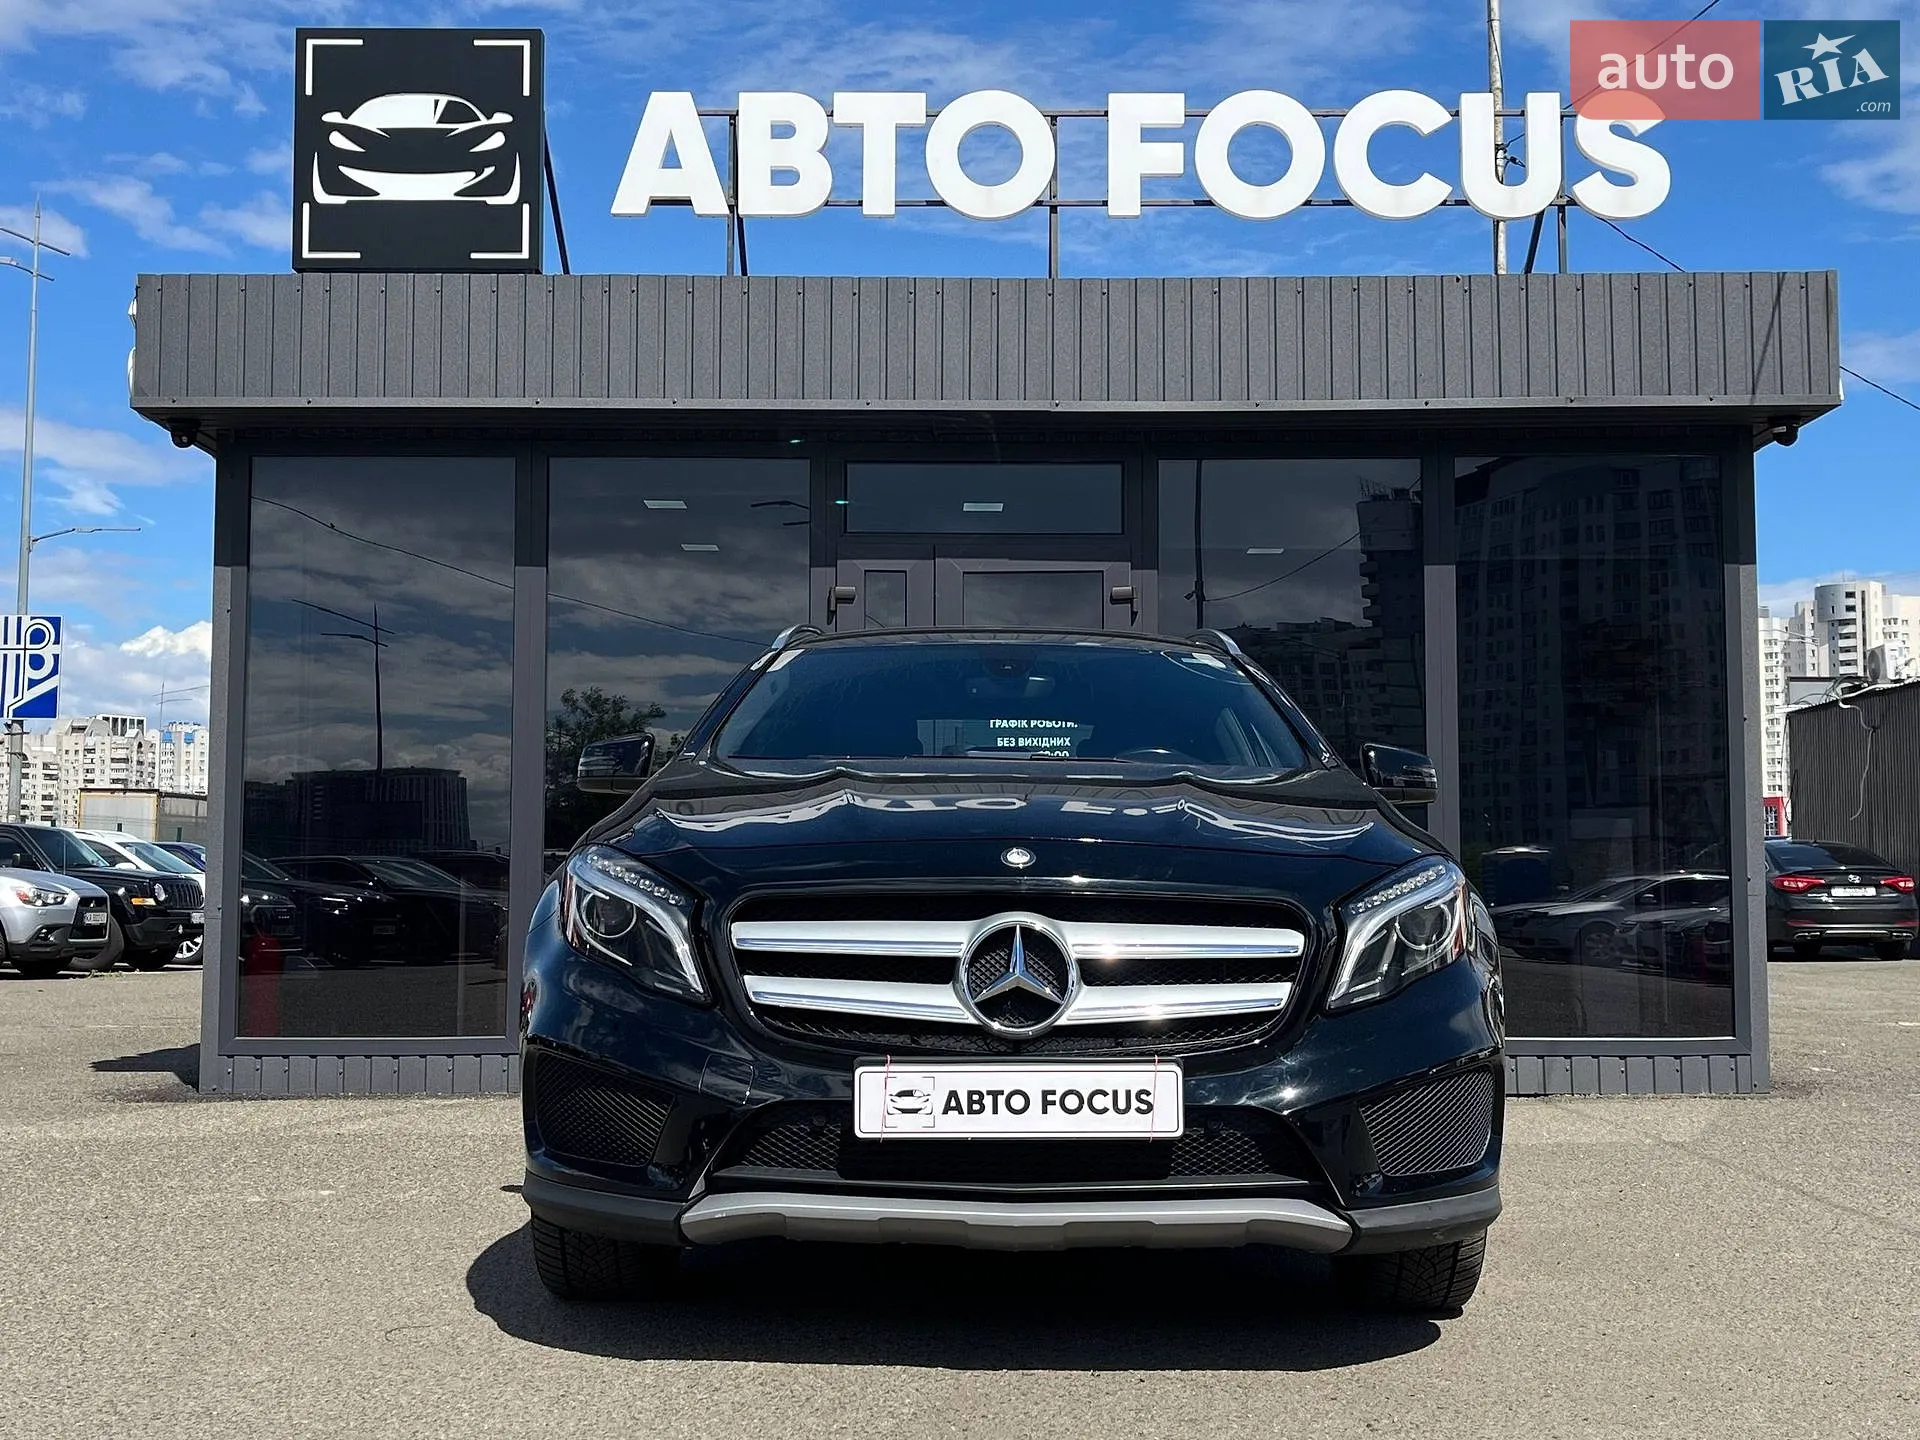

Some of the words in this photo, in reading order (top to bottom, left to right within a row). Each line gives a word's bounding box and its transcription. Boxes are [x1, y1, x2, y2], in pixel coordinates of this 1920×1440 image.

[610, 90, 1057, 219] АВТО
[1106, 89, 1672, 220] FOCUS
[989, 719, 1029, 728] ГРАФІК
[997, 737, 1016, 747] БЕЗ
[1018, 737, 1071, 748] ВИХІДНИХ
[942, 1089, 1031, 1116] АВТО
[1041, 1088, 1154, 1116] FOCUS
